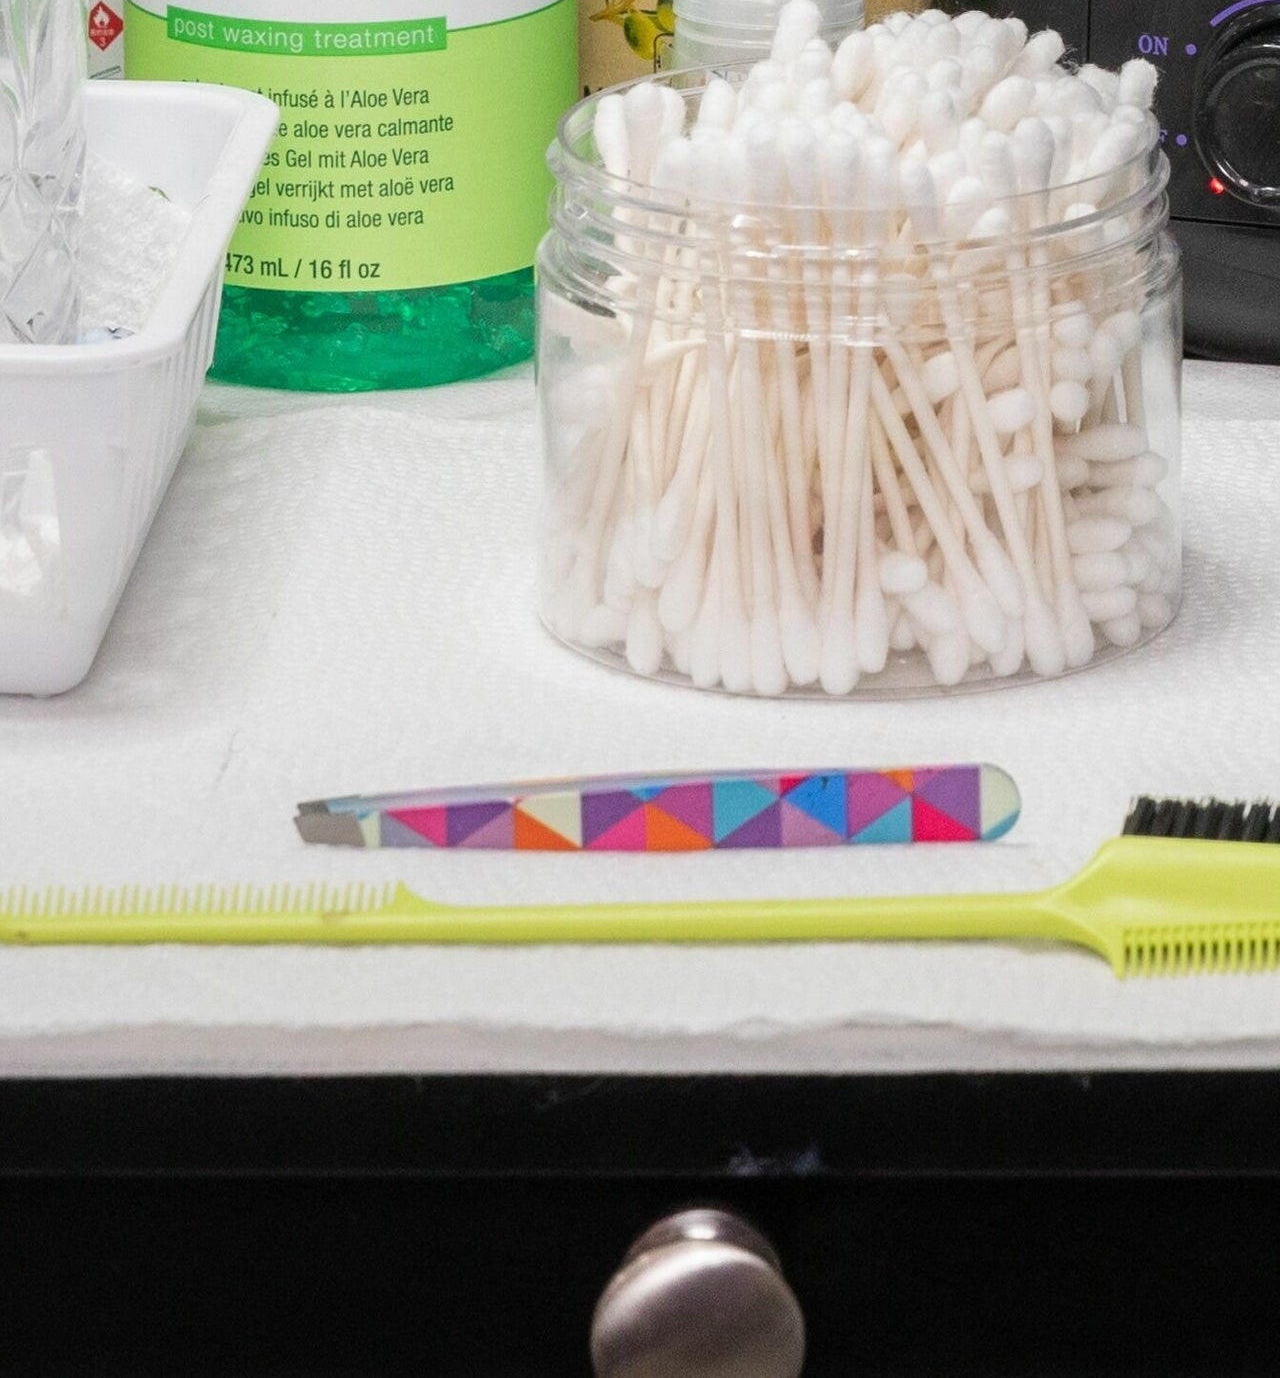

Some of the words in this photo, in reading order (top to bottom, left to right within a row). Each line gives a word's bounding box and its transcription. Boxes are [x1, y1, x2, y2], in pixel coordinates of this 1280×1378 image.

[173, 16, 216, 42] post
[223, 24, 304, 52] waxing
[313, 22, 436, 49] treatment
[1138, 34, 1169, 56] ON
[324, 92, 335, 109] à
[392, 88, 430, 106] Vera
[293, 120, 329, 139] aloe
[334, 122, 372, 138] vera
[377, 113, 454, 137] calmante
[285, 149, 312, 168] Gel
[319, 149, 346, 169] mit
[350, 149, 388, 168] Aloe
[392, 148, 430, 166] Vera
[275, 180, 334, 202] verrijkt
[340, 182, 374, 199] met
[419, 175, 455, 194] vera
[269, 207, 320, 229] infuso
[325, 209, 341, 228] di
[347, 209, 382, 228] aloe
[387, 208, 425, 226] vera
[260, 257, 290, 278] mL
[308, 260, 333, 279] 16
[338, 259, 352, 279] fl
[357, 261, 381, 278] oz
